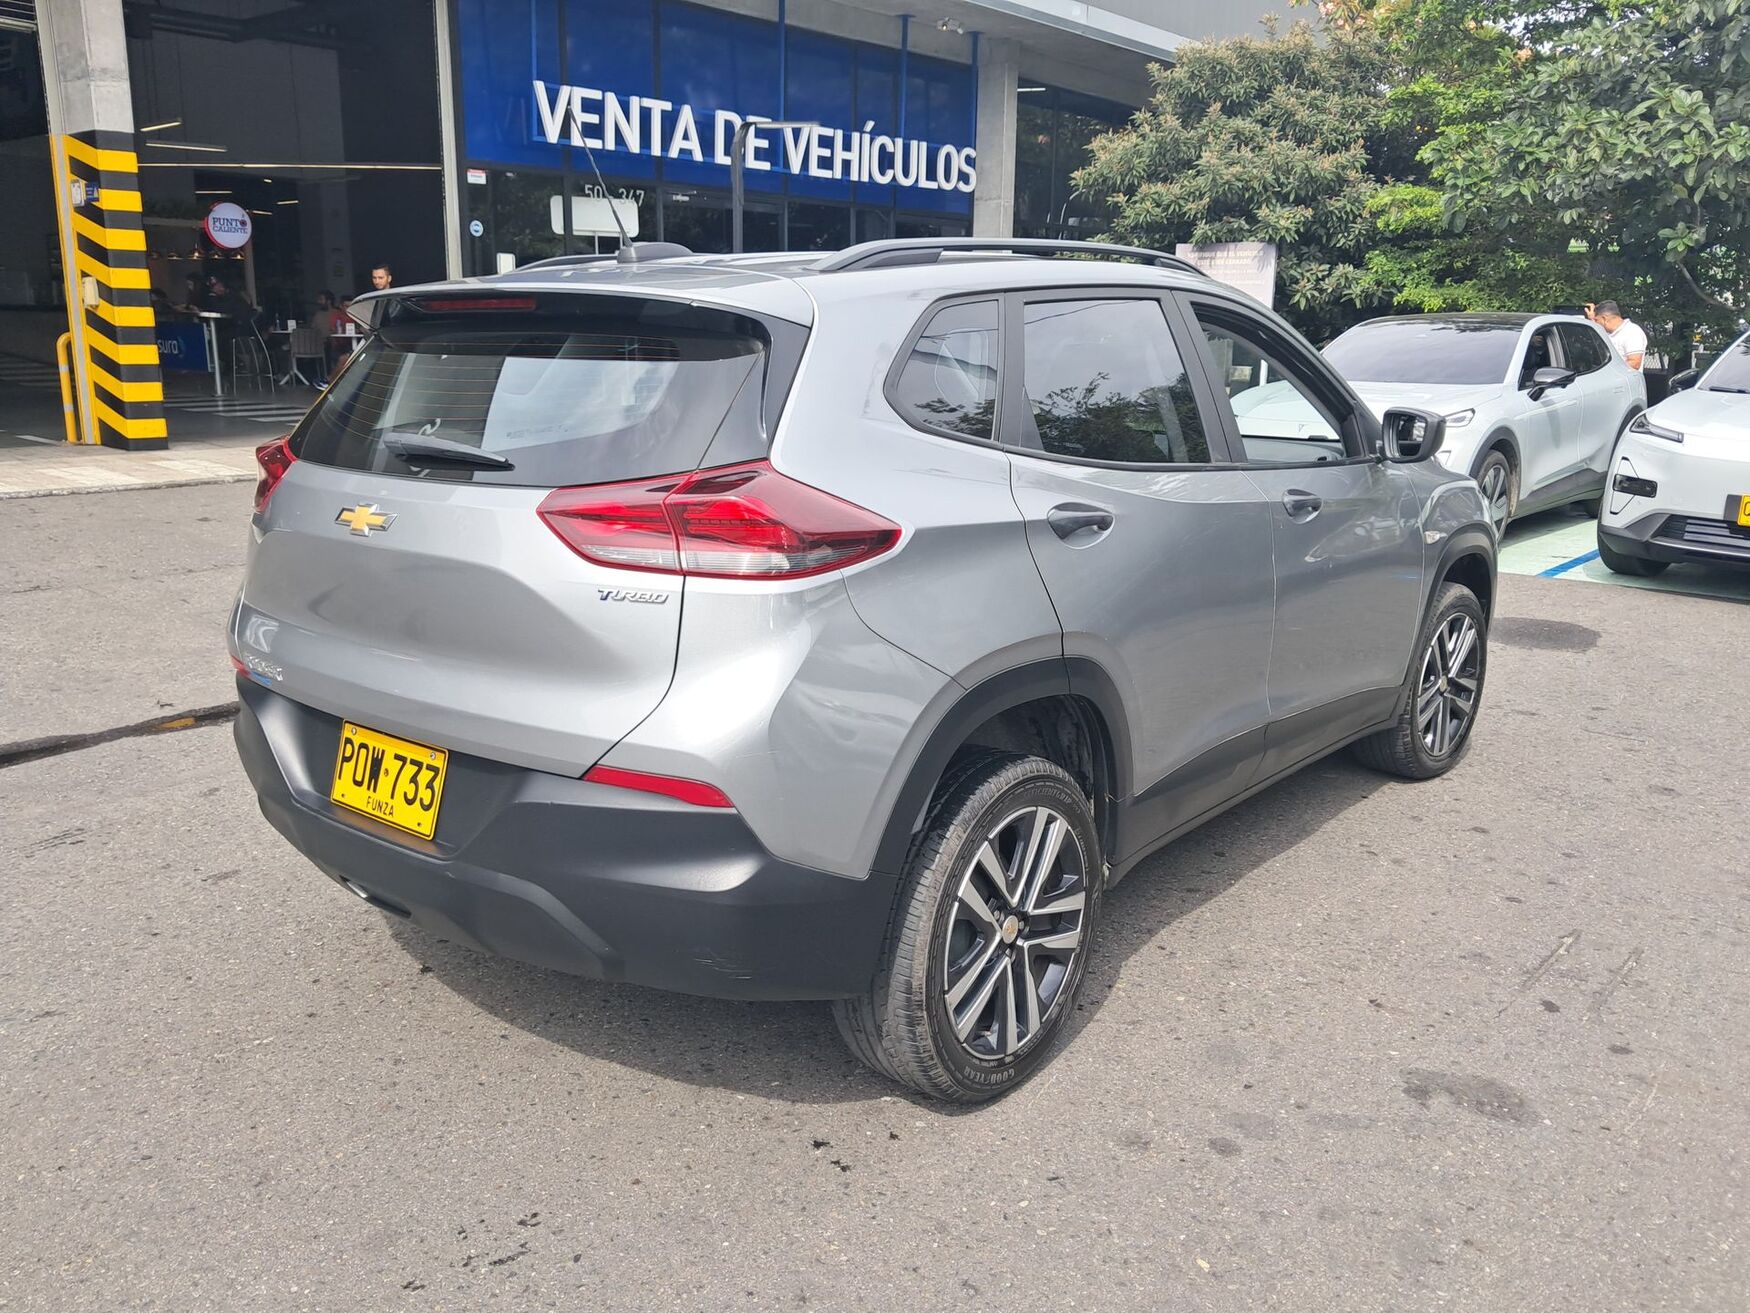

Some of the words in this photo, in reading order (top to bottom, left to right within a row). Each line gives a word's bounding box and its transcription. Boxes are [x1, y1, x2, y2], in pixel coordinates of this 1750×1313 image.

[533, 80, 703, 162] VENTA
[714, 109, 773, 171] DE
[783, 120, 977, 193] VEHÍCULOS
[212, 217, 248, 228] PUNTO
[212, 225, 248, 235] CALIENTE
[157, 339, 179, 354] sura
[598, 589, 669, 605] TURBO
[390, 752, 441, 812] 733
[366, 796, 395, 818] FUNZA
